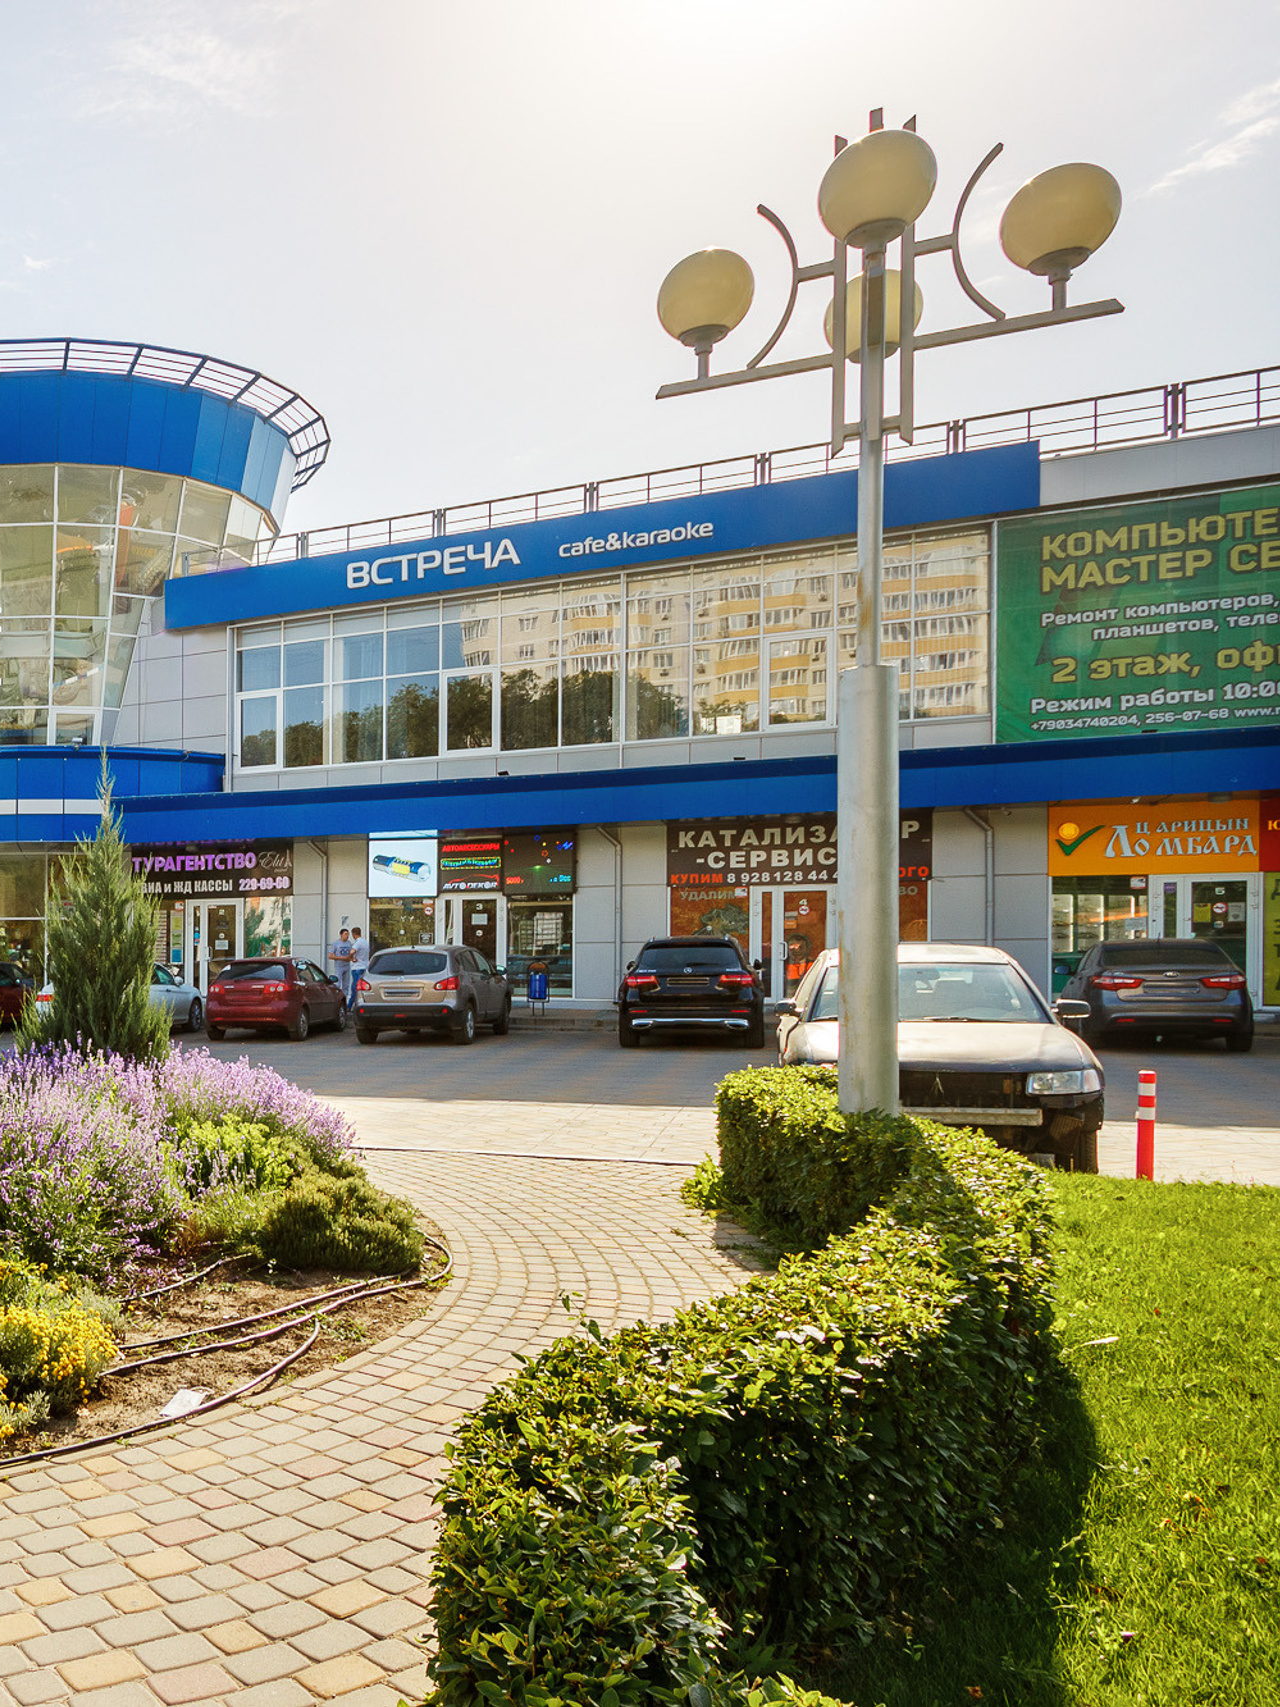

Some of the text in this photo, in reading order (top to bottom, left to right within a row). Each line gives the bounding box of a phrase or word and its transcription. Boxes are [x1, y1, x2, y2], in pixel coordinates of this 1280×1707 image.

[558, 521, 714, 558] cafe&karaoke
[1041, 507, 1280, 561] КОМПЬЮТЕ
[346, 538, 521, 589] ВСТРЕЧА
[1041, 548, 1213, 593] МАСТЕР
[1040, 593, 1280, 627] Ремонт компьютеров,
[1092, 611, 1280, 641] планшетов, теле
[1051, 640, 1280, 683] 2 этаж, оф
[1031, 681, 1280, 714] Режим работы 10:0
[1145, 707, 1229, 724] 256-07-68
[1233, 704, 1280, 717] www.
[678, 820, 920, 849] КАТАЛИЗР
[131, 851, 257, 872] ТУРАГЕНТСТВО
[173, 880, 193, 895] ЖД
[194, 879, 233, 893] КАССЫ
[670, 872, 724, 885] КУПИМ
[726, 872, 736, 884] 8
[741, 871, 771, 883] 928
[773, 870, 804, 883] 128
[808, 869, 828, 882] 44
[475, 903, 484, 911] 3
[799, 898, 808, 906] 4
